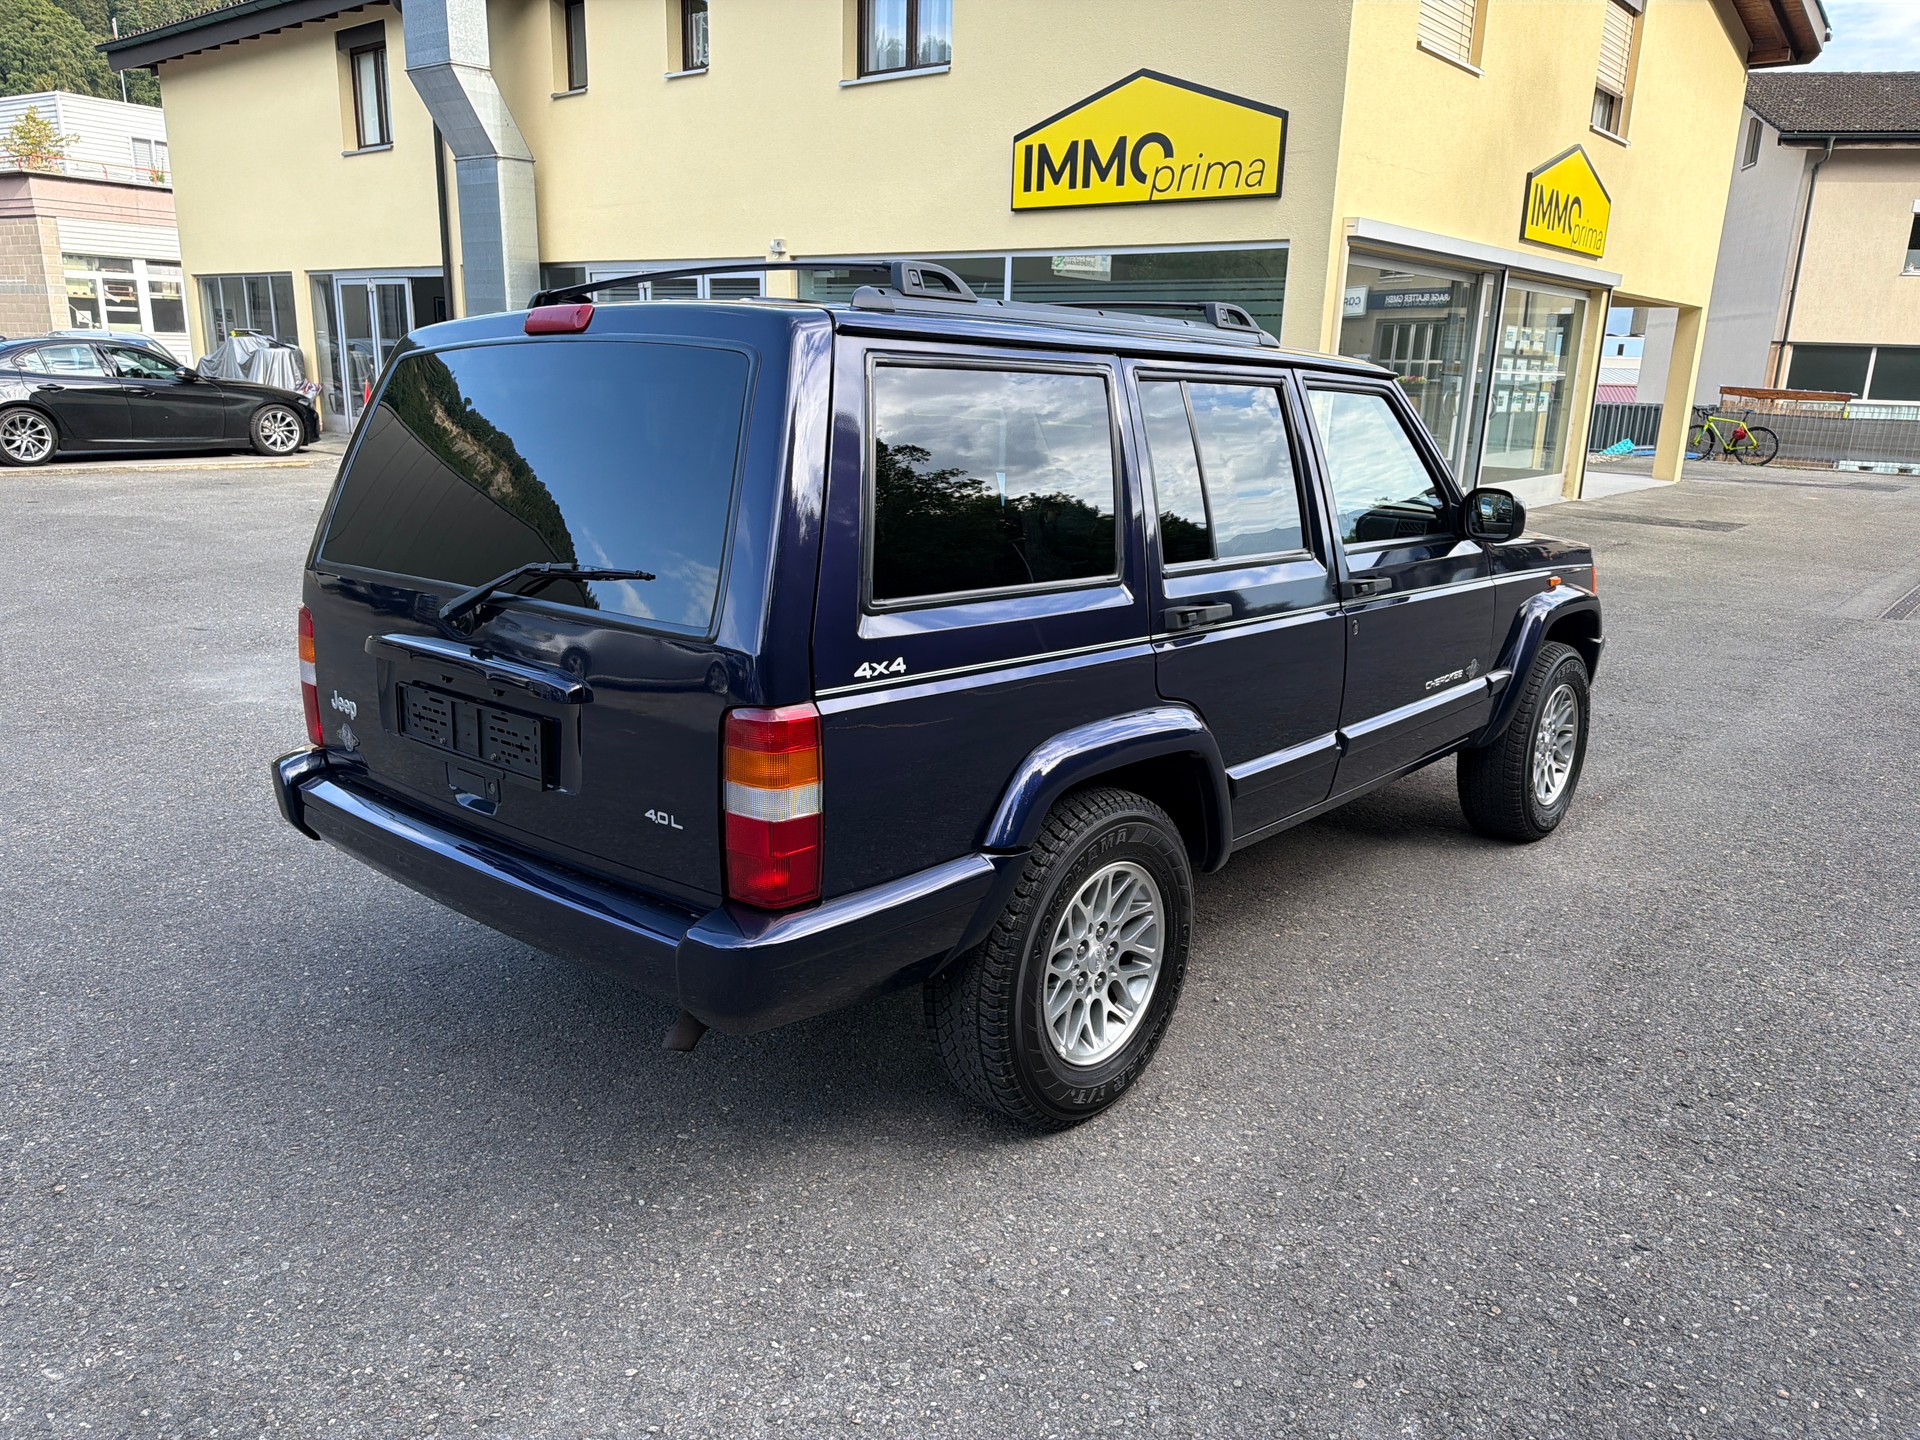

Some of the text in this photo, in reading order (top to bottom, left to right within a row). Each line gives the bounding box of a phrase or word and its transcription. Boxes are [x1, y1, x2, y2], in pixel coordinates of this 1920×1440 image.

[853, 656, 907, 679] 4x4
[1425, 669, 1464, 690] CHEROKEE
[331, 690, 357, 720] Jeep
[1033, 827, 1128, 960] YOKOHAMA
